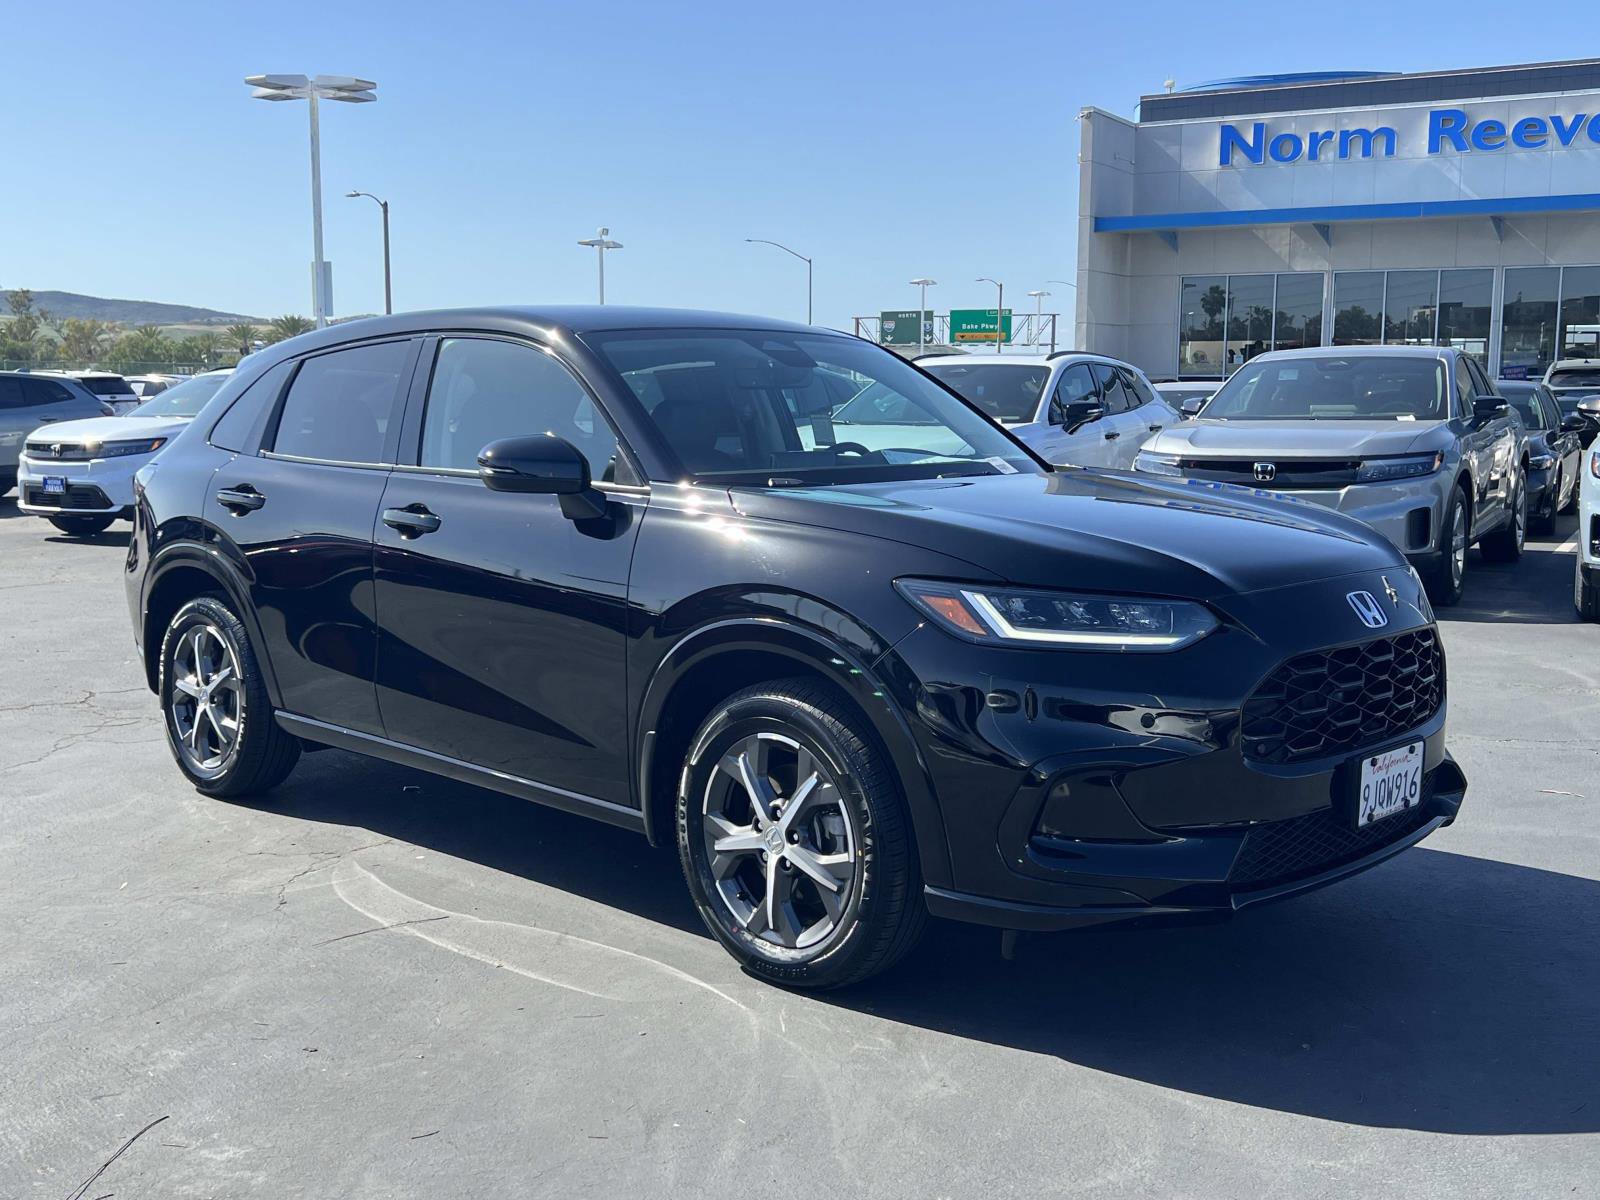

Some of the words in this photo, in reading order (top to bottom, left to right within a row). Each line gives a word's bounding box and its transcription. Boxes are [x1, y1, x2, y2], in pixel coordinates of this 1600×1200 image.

[1219, 122, 1398, 166] Norm
[980, 323, 999, 331] Pkwy
[1361, 765, 1420, 819] 9JQW916
